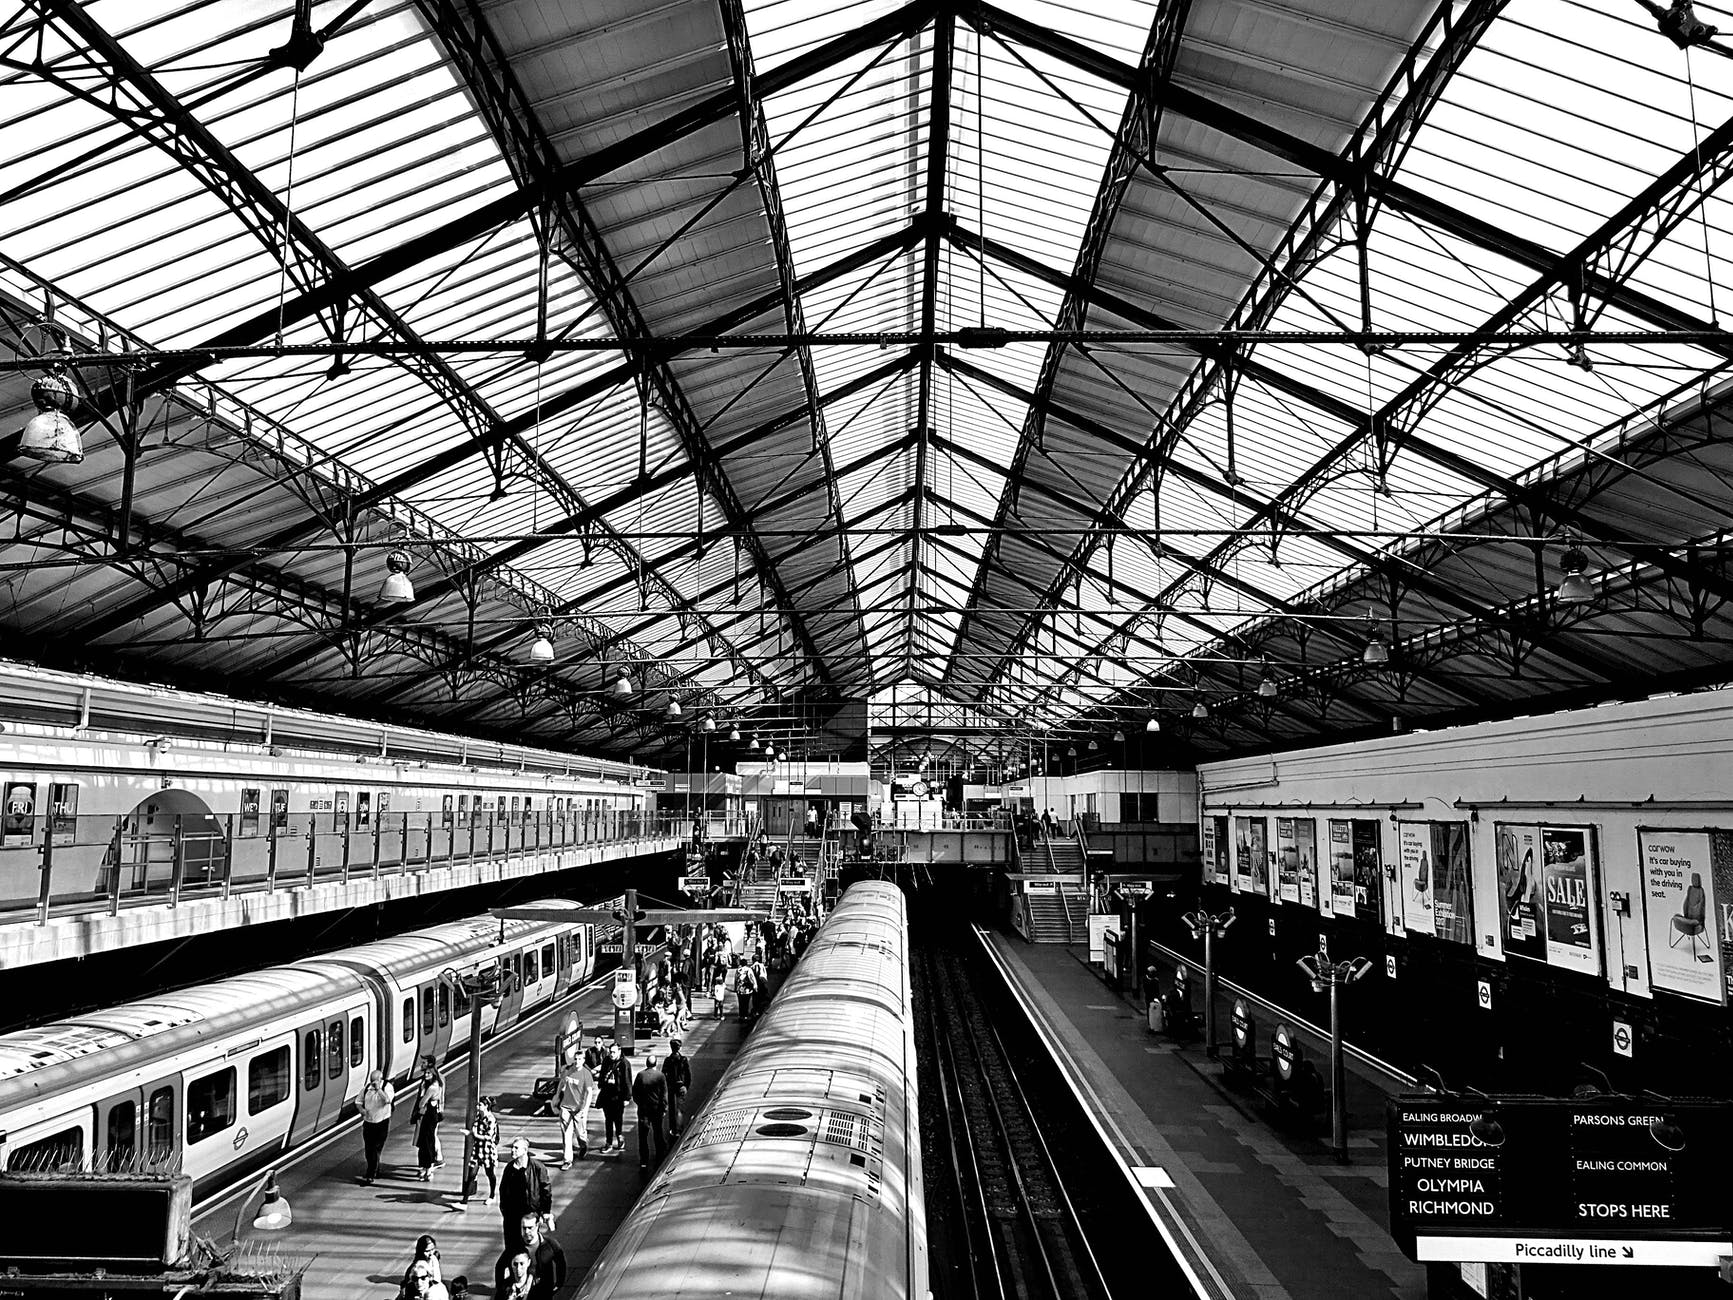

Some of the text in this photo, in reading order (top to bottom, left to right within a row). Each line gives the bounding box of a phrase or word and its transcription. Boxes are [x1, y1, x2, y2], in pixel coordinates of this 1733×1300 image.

[12, 801, 28, 814] FRI
[54, 802, 74, 814] THU
[1648, 844, 1675, 853] carwow
[1670, 858, 1691, 868] buying
[1650, 867, 1683, 878] with you in
[1651, 879, 1682, 890] the driving
[1547, 876, 1586, 908] SALE
[1403, 1113, 1483, 1122] EALING BROADW
[1573, 1115, 1625, 1125] PARSONS
[1404, 1133, 1487, 1147] WIMBLEDO
[1404, 1157, 1495, 1169] PUTNEY BRIDGE
[1576, 1160, 1667, 1171] EALING COMMON
[1417, 1179, 1485, 1193] OLYMPIA
[1409, 1200, 1494, 1215] RICHMOND
[1578, 1203, 1670, 1218] STOPS HERE
[1515, 1243, 1616, 1260] Piccadilly line
